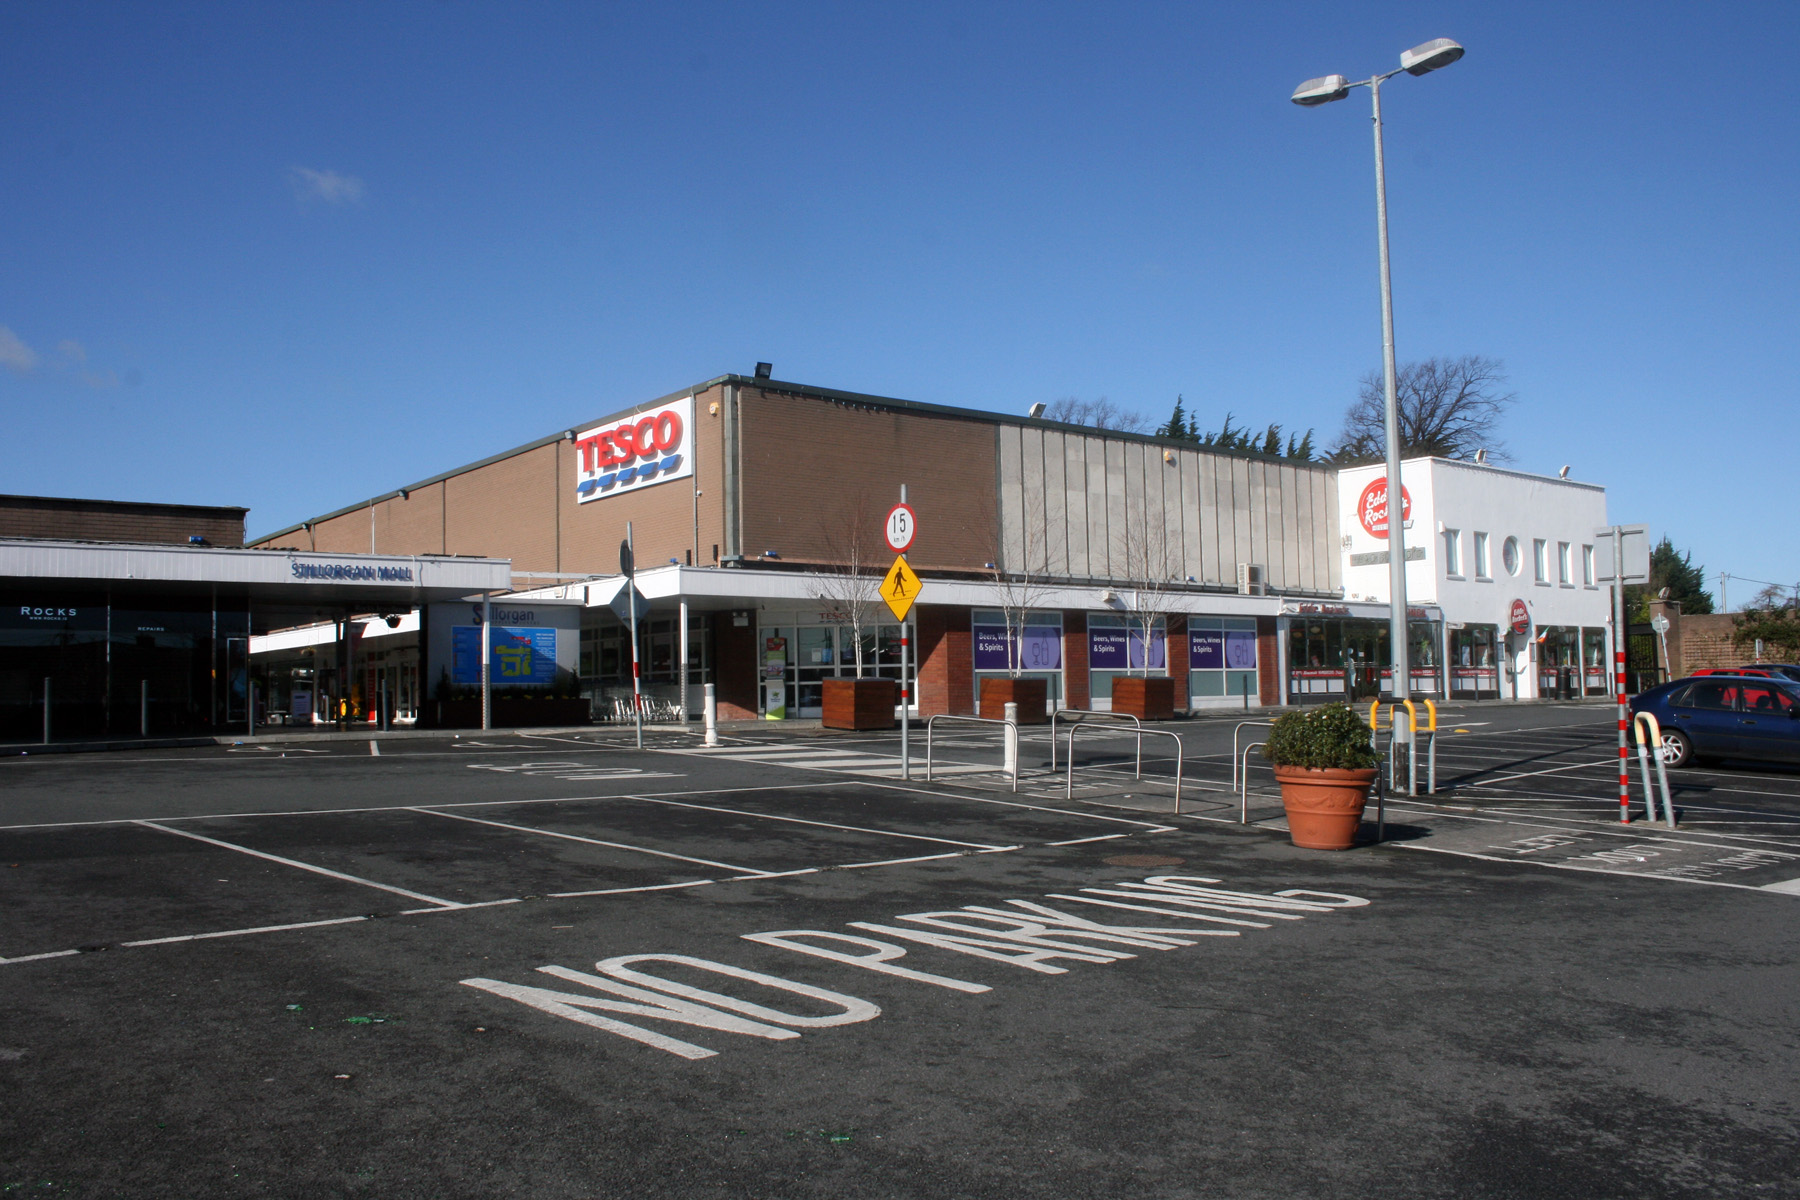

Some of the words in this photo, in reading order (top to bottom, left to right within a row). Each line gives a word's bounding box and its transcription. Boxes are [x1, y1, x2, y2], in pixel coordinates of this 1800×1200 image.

[575, 410, 683, 474] TESCO
[893, 513, 906, 534] 15
[292, 563, 374, 579] STILLORGAN
[377, 566, 413, 580] MALL
[20, 606, 77, 616] ROCKS
[472, 603, 535, 625] Sllorgan
[978, 632, 997, 641] Beers,
[1093, 635, 1109, 643] Beers,
[1193, 636, 1207, 644] Beers,
[979, 643, 984, 651] &
[984, 642, 1004, 652] Spirits
[1098, 644, 1115, 653] Spirits
[1197, 645, 1212, 654] Spirits
[1487, 834, 1593, 854] LEFT
[458, 952, 882, 1062] NO
[740, 875, 1371, 994] PARKING
